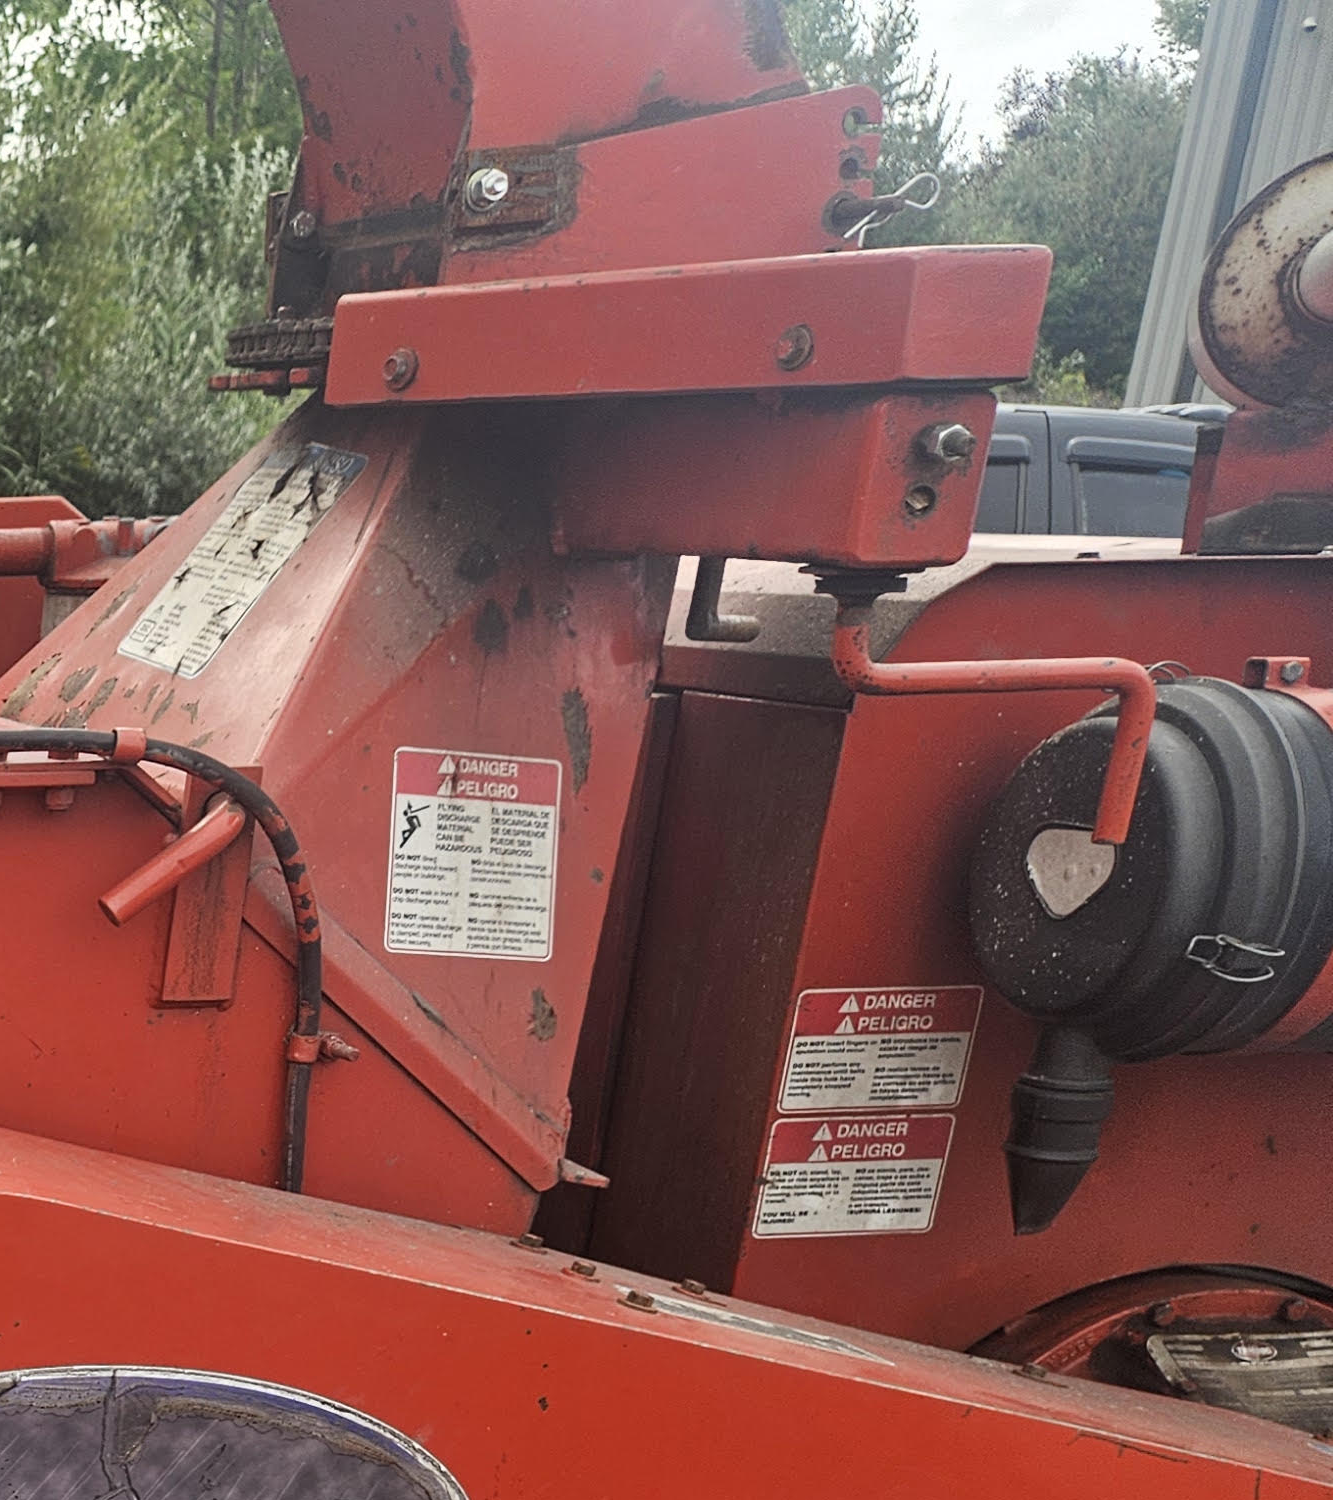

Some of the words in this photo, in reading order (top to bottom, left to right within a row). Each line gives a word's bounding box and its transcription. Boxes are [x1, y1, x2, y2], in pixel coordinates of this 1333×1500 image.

[458, 758, 518, 778] DANGER
[456, 779, 519, 799] PELIGRO
[862, 993, 937, 1009] DANGER
[856, 1014, 934, 1031] PELIGRO
[836, 1121, 909, 1138] DANGER
[830, 1142, 906, 1159] PELIGRO
